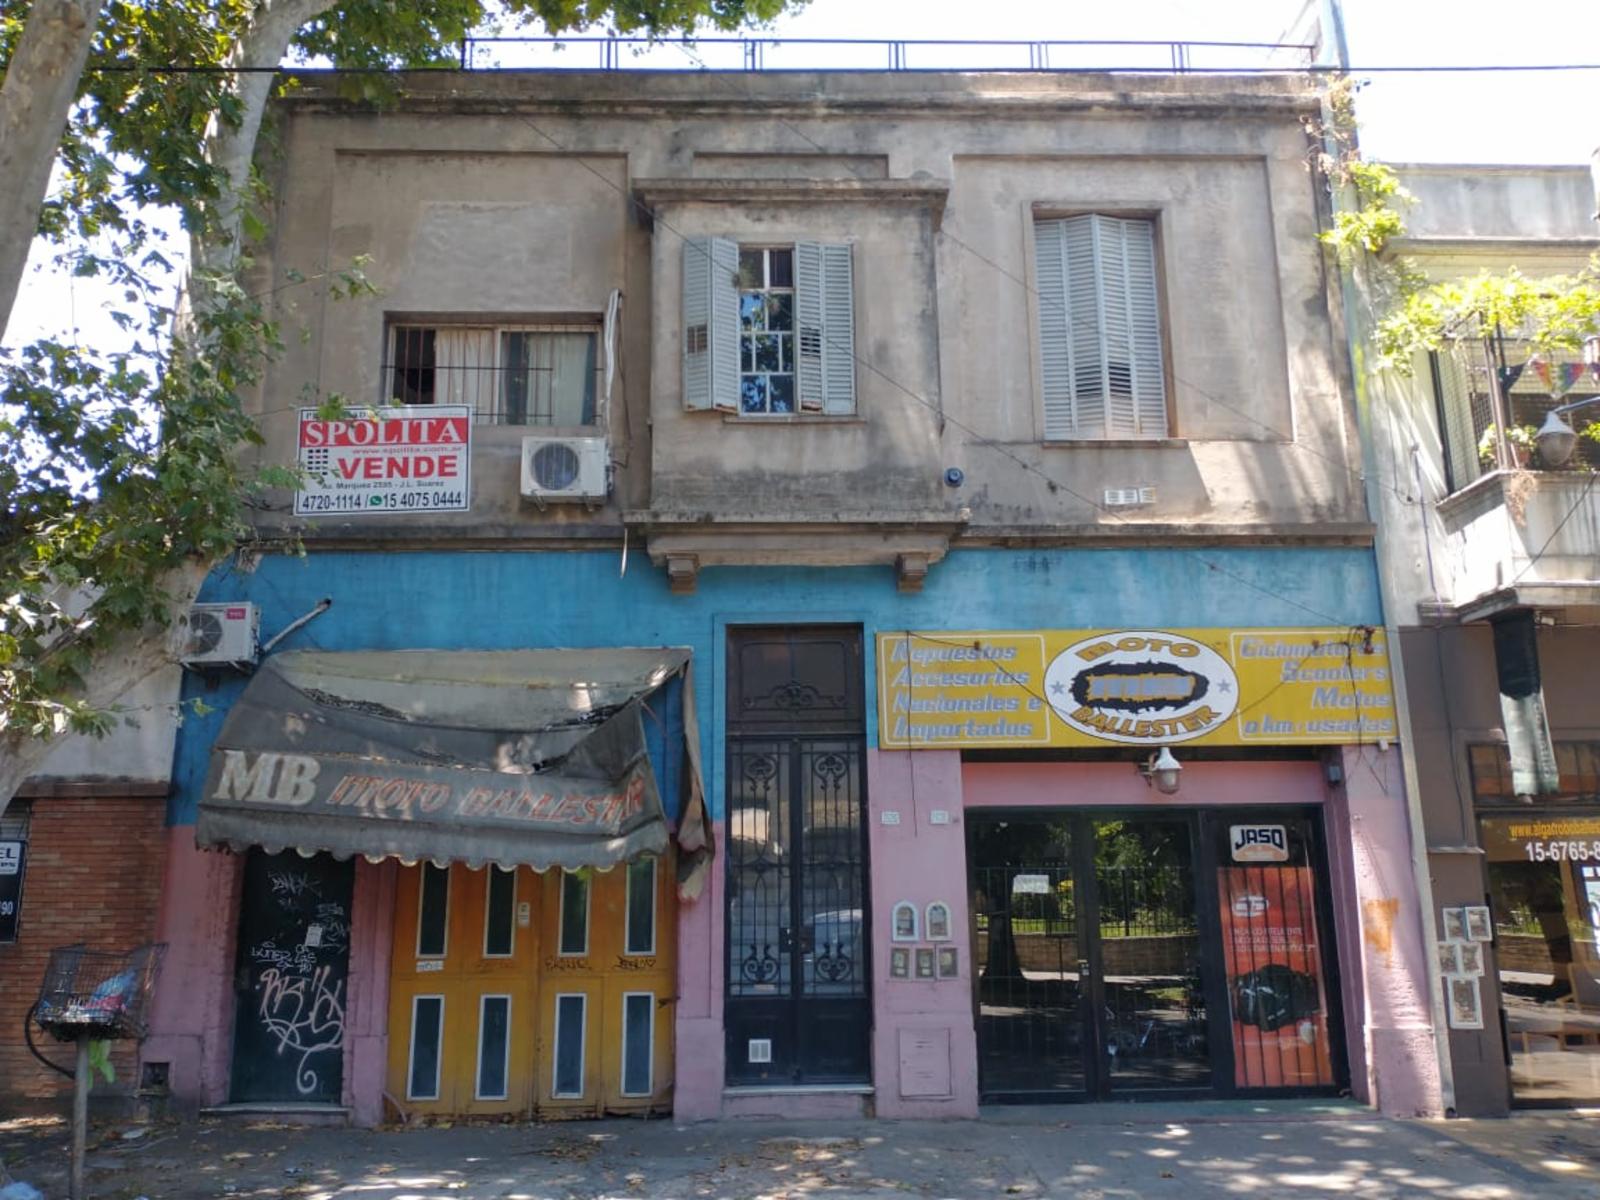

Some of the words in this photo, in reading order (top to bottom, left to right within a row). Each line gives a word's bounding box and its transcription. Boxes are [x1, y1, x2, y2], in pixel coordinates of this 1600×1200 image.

[304, 419, 462, 446] SPOLITA
[337, 455, 458, 480] VENDE
[302, 493, 362, 510] 4720-1114
[383, 492, 397, 507] 15
[400, 492, 430, 507] 4075
[432, 490, 462, 506] 0444
[890, 640, 1017, 664] Repuestos
[1075, 637, 1201, 662] MOTO
[891, 666, 1030, 687] Accesorios
[1281, 660, 1388, 683] Scooters
[892, 692, 1020, 713] Nacionales
[1312, 686, 1390, 709] Motos
[892, 716, 1033, 741] Importados
[1070, 705, 1222, 738] BALLESTER
[211, 750, 321, 807] MB
[1234, 828, 1284, 850] JASO
